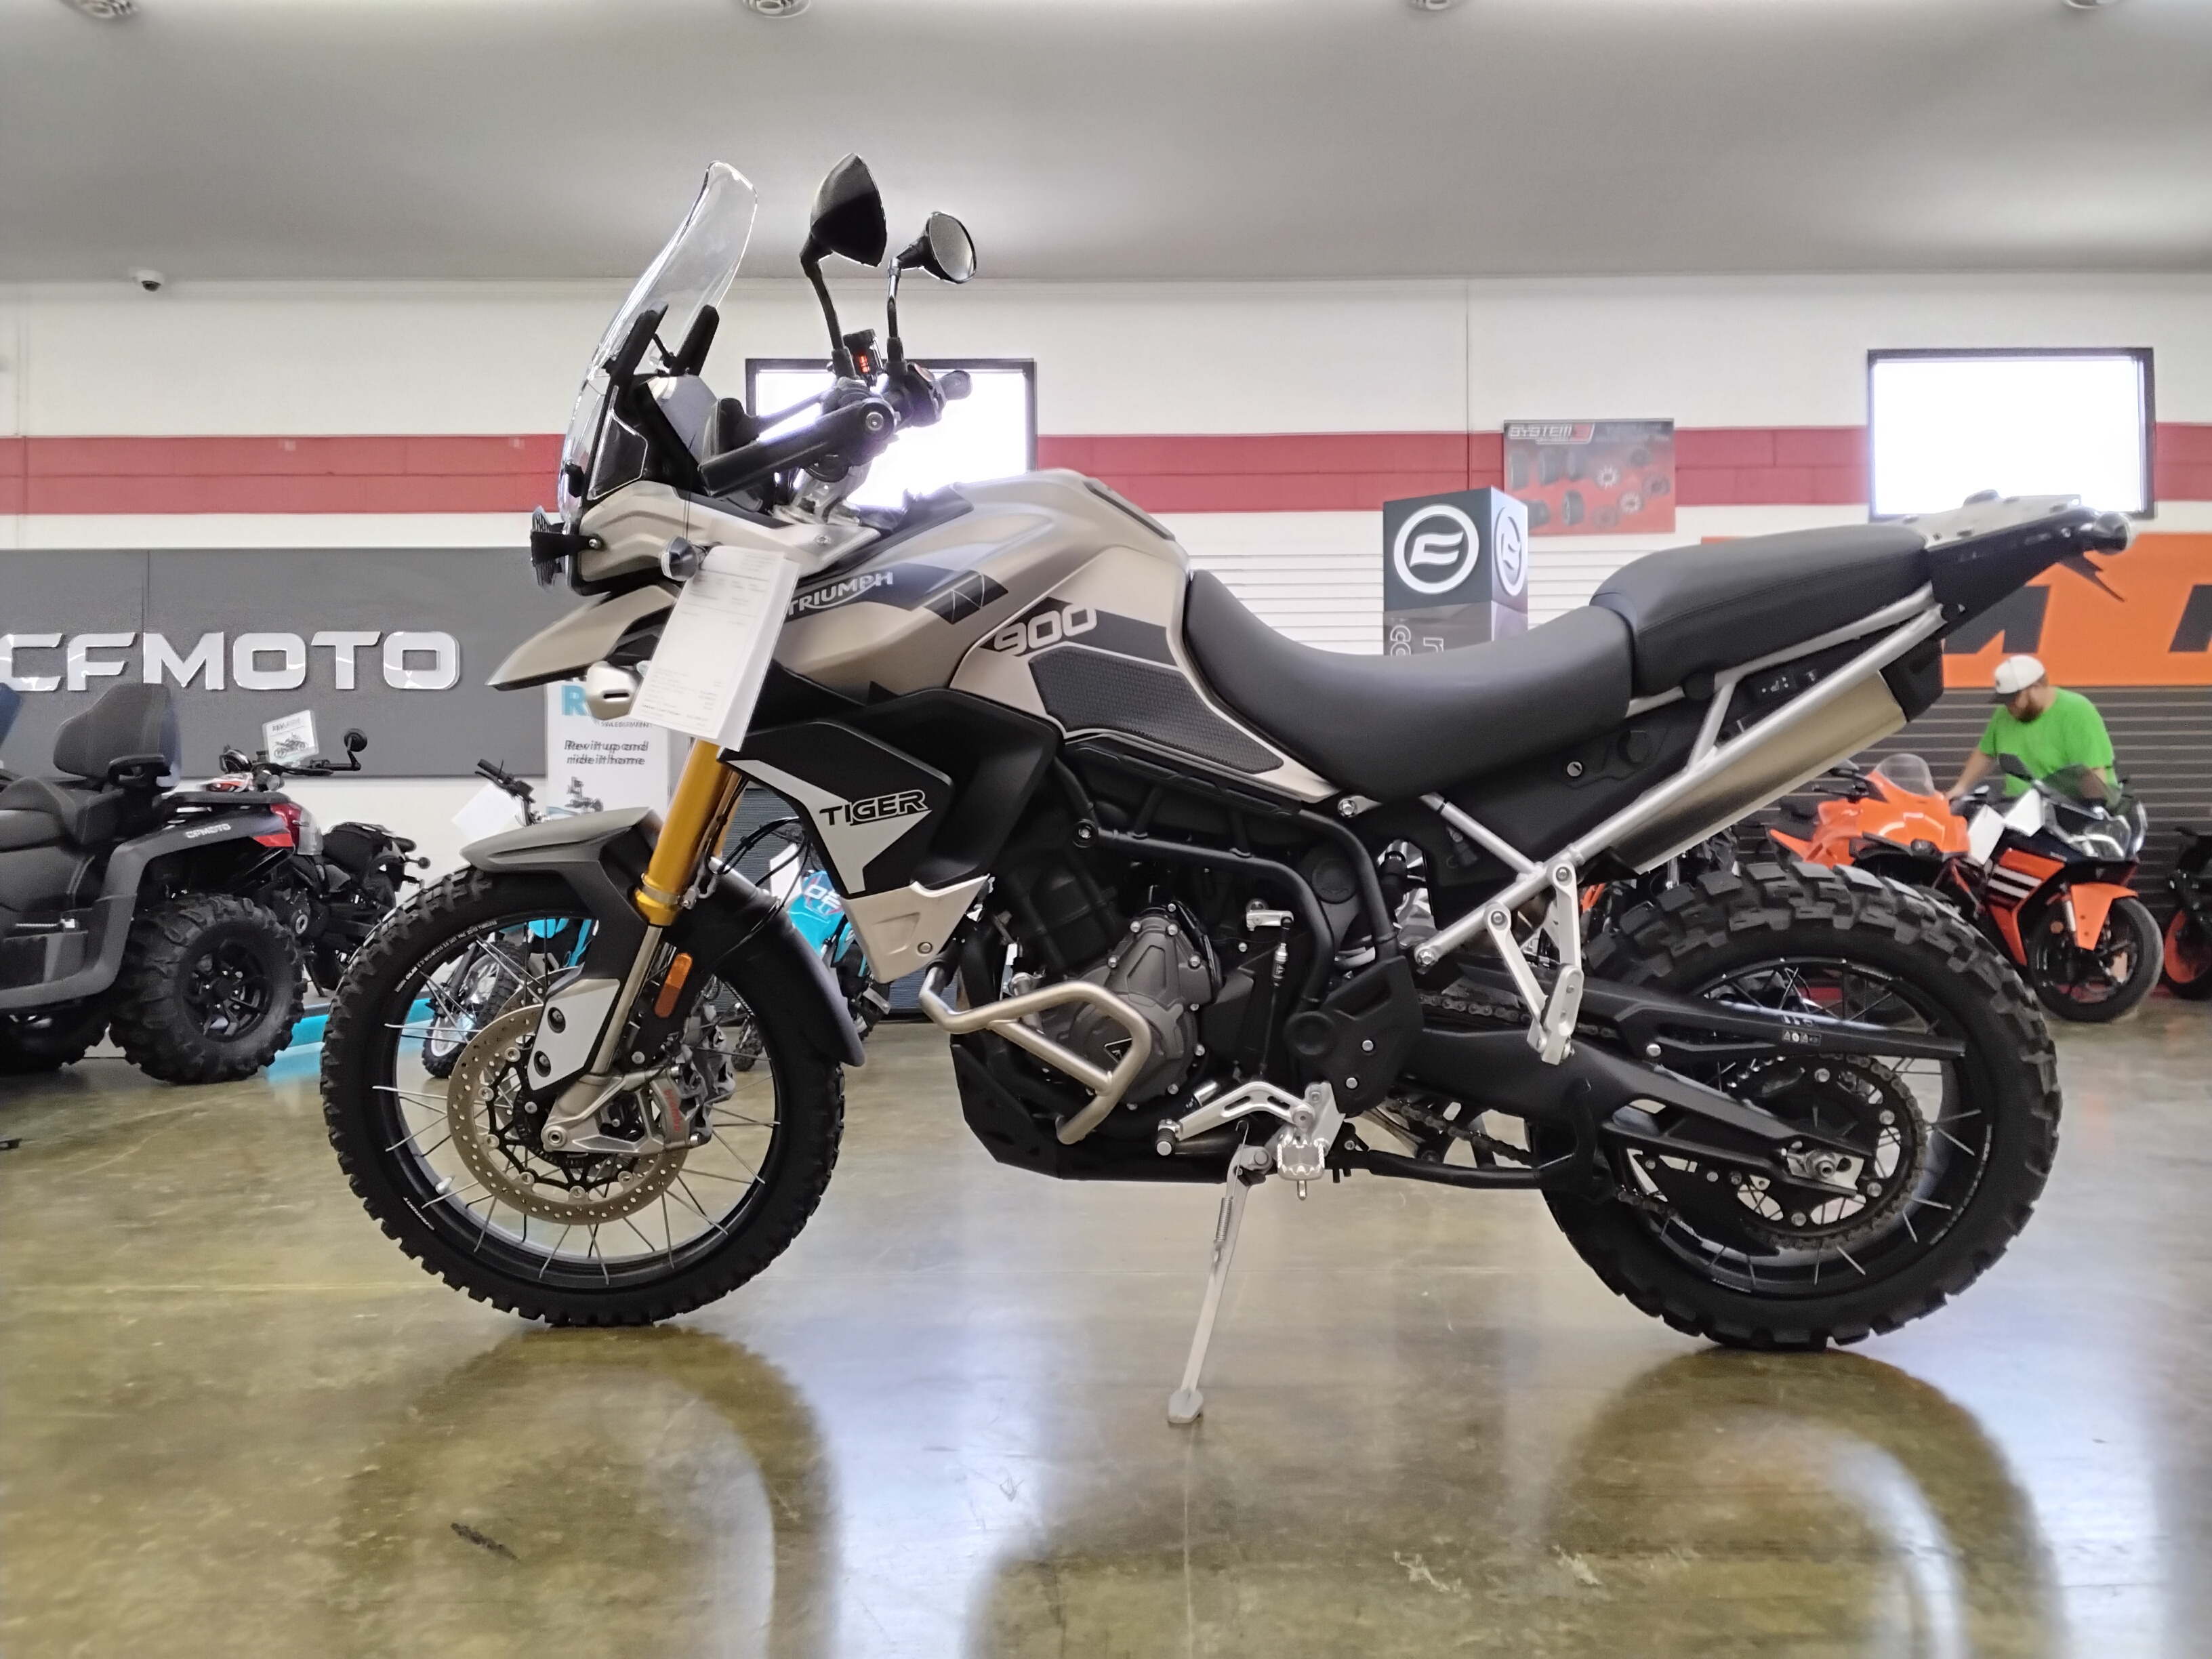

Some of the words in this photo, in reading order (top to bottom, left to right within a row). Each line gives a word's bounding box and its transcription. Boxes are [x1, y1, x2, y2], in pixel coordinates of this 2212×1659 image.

[1510, 426, 1572, 437] SYSTEM
[788, 571, 894, 616] TRIUMPH
[994, 603, 1097, 655] 900
[0, 631, 460, 691] CFMOTO
[607, 754, 646, 765] home
[819, 790, 929, 826] TIGER
